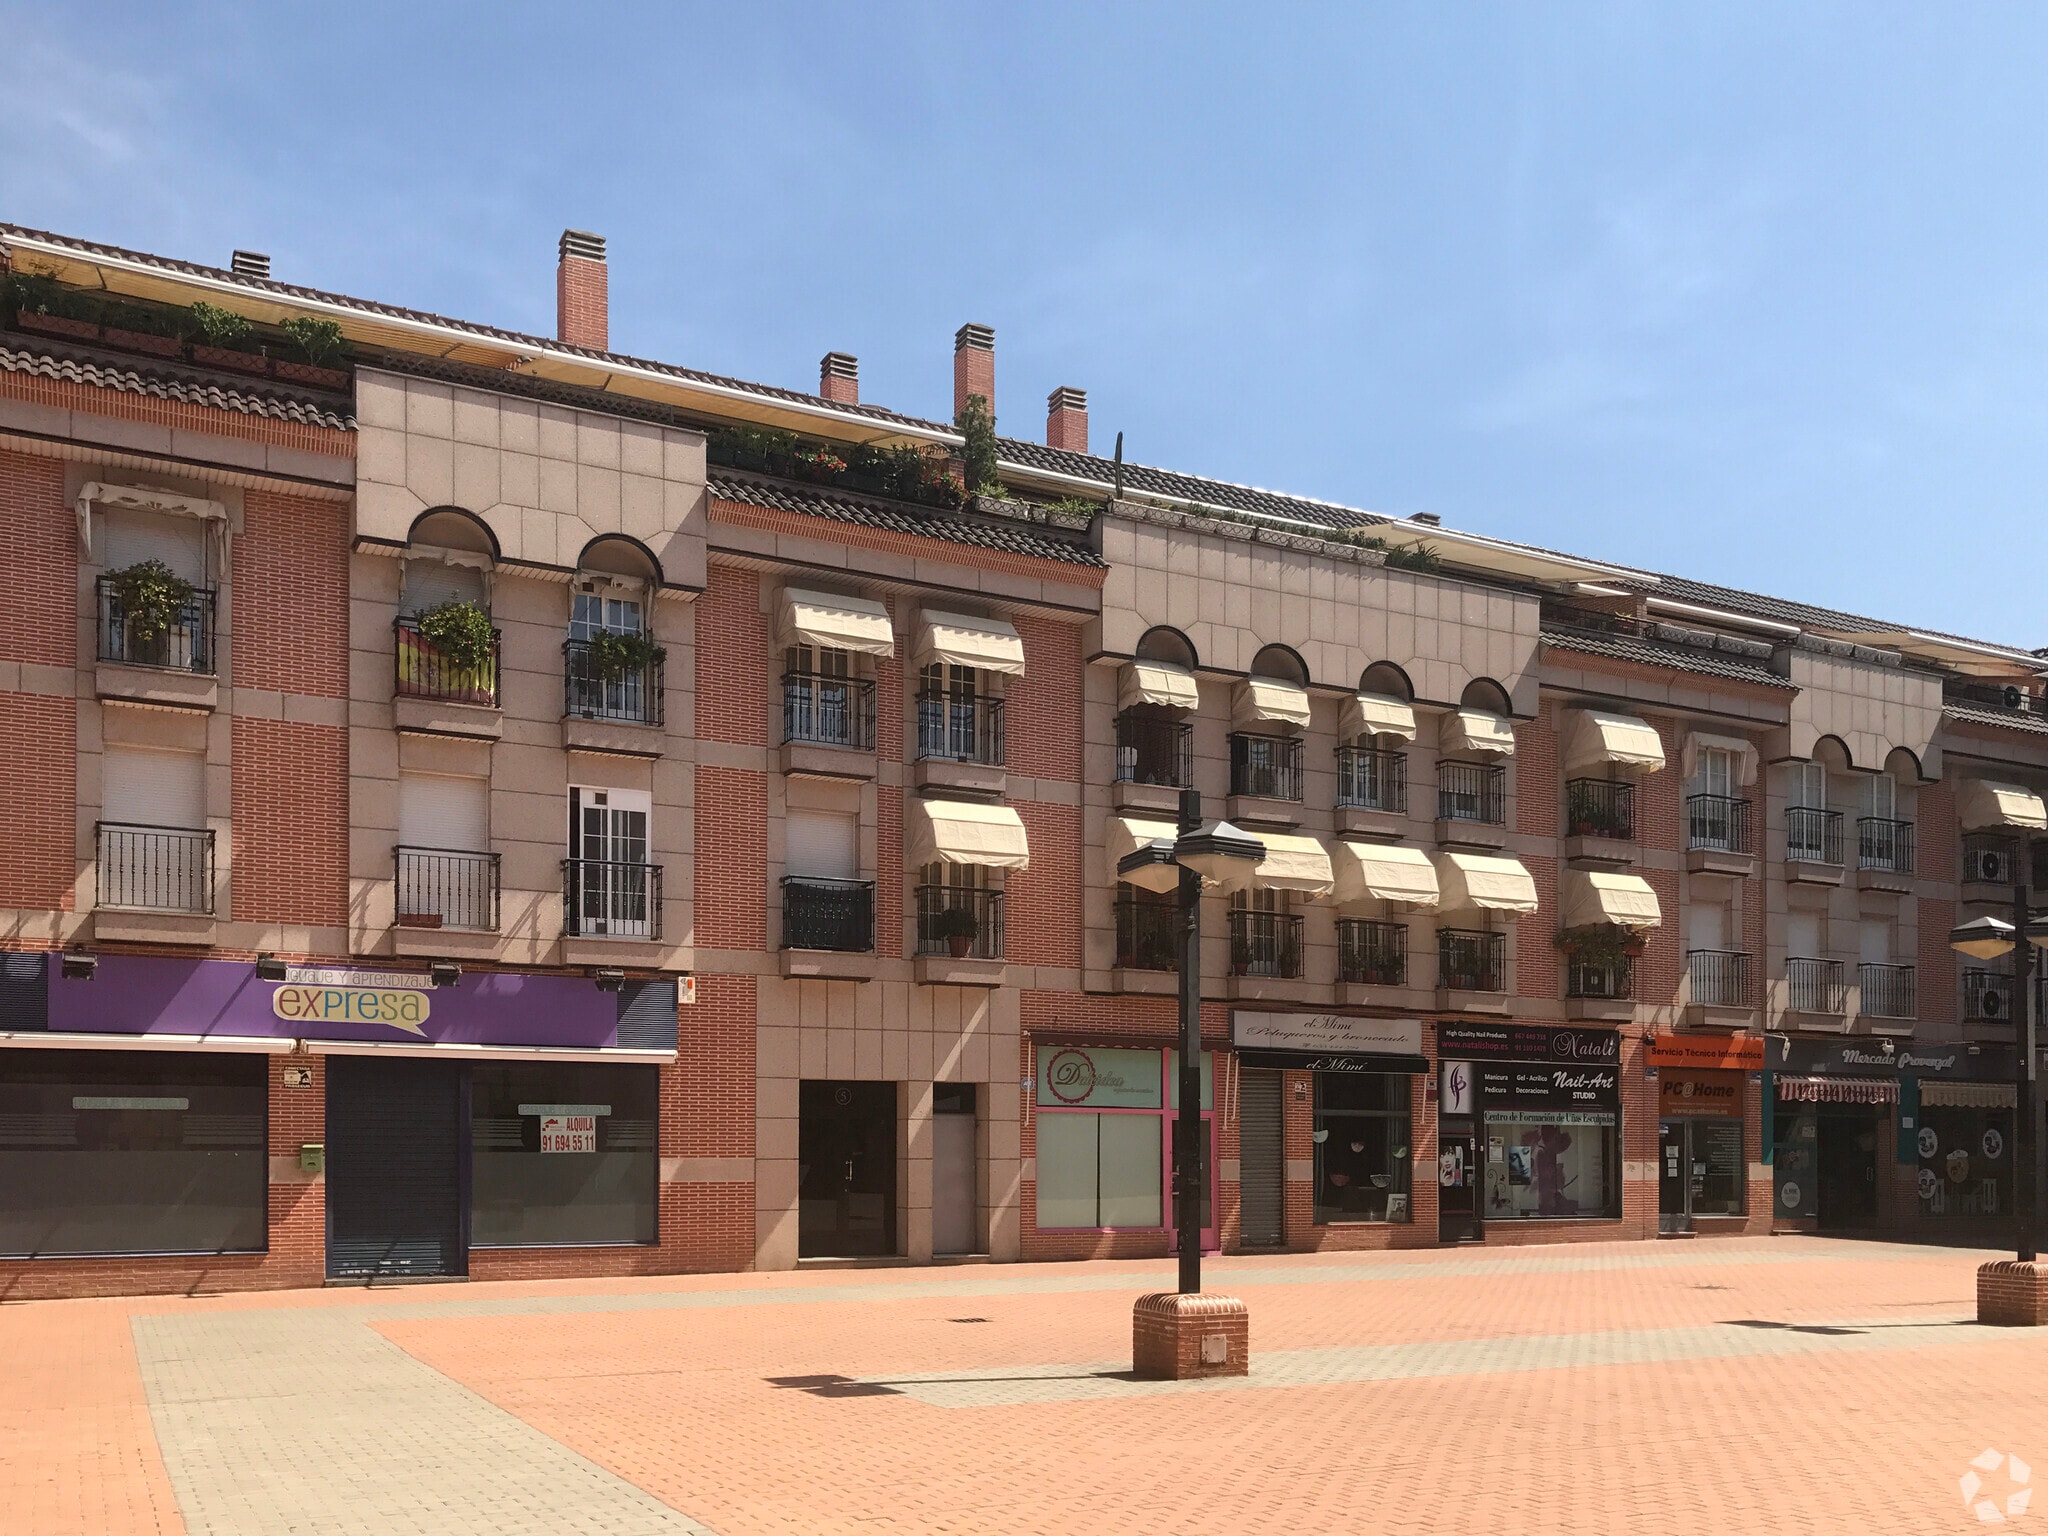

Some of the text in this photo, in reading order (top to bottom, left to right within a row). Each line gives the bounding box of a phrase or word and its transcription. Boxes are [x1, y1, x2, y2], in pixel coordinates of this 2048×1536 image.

[278, 988, 421, 1022] expresa
[1328, 1032, 1338, 1042] y
[1441, 1040, 1509, 1051] www.natalishop.es
[1552, 1031, 1616, 1059] Natali
[1651, 1047, 1762, 1060] Servicio Técnico Informático
[1842, 1049, 1956, 1071] Mercado Provenzal
[1484, 1073, 1508, 1081] Manicura
[1552, 1071, 1614, 1089] Nail-Art
[1484, 1086, 1507, 1094] Pedicura
[1515, 1087, 1549, 1095] Decoraciones
[1572, 1092, 1596, 1100] STUDIO
[1662, 1081, 1735, 1098] PC@Home
[566, 1117, 594, 1131] ALQUILA
[1484, 1111, 1508, 1121] Centro
[1509, 1112, 1518, 1121] de
[1519, 1112, 1555, 1122] Formación
[1556, 1112, 1565, 1122] de
[1583, 1113, 1616, 1125] Esculpidas
[542, 1134, 594, 1151] 91 694 55 11
